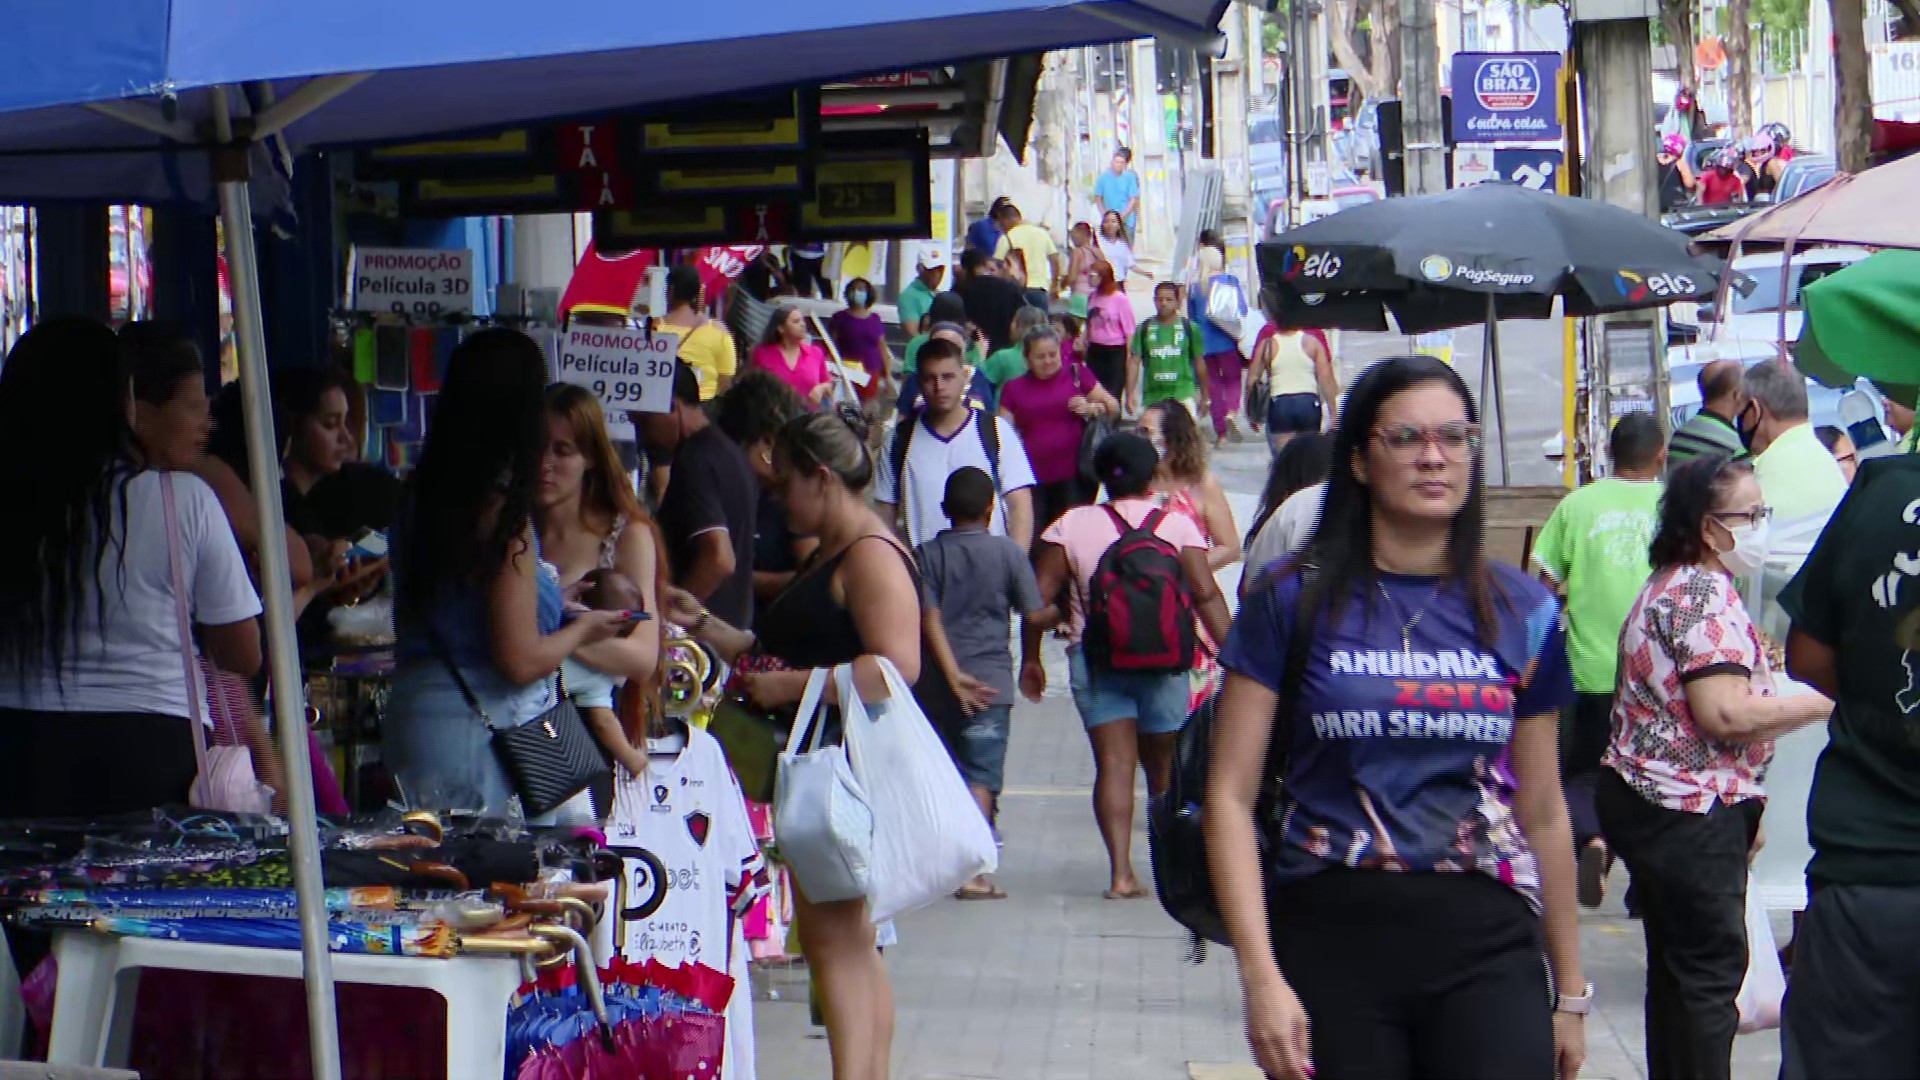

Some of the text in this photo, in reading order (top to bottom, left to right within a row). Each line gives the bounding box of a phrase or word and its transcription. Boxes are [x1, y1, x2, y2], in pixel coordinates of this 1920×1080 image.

[1490, 62, 1524, 78] SÃO
[1482, 78, 1531, 91] BRAZ
[365, 254, 462, 272] PROMOÇÃO
[1303, 251, 1342, 279] elo
[359, 276, 469, 295] Película 3D
[1456, 264, 1534, 286] PagSeguro
[1647, 272, 1696, 296] elo
[563, 353, 673, 378] Película 3D
[593, 380, 642, 403] 9,99
[1329, 648, 1502, 679] ANUIDADE
[1311, 709, 1383, 740] PARA
